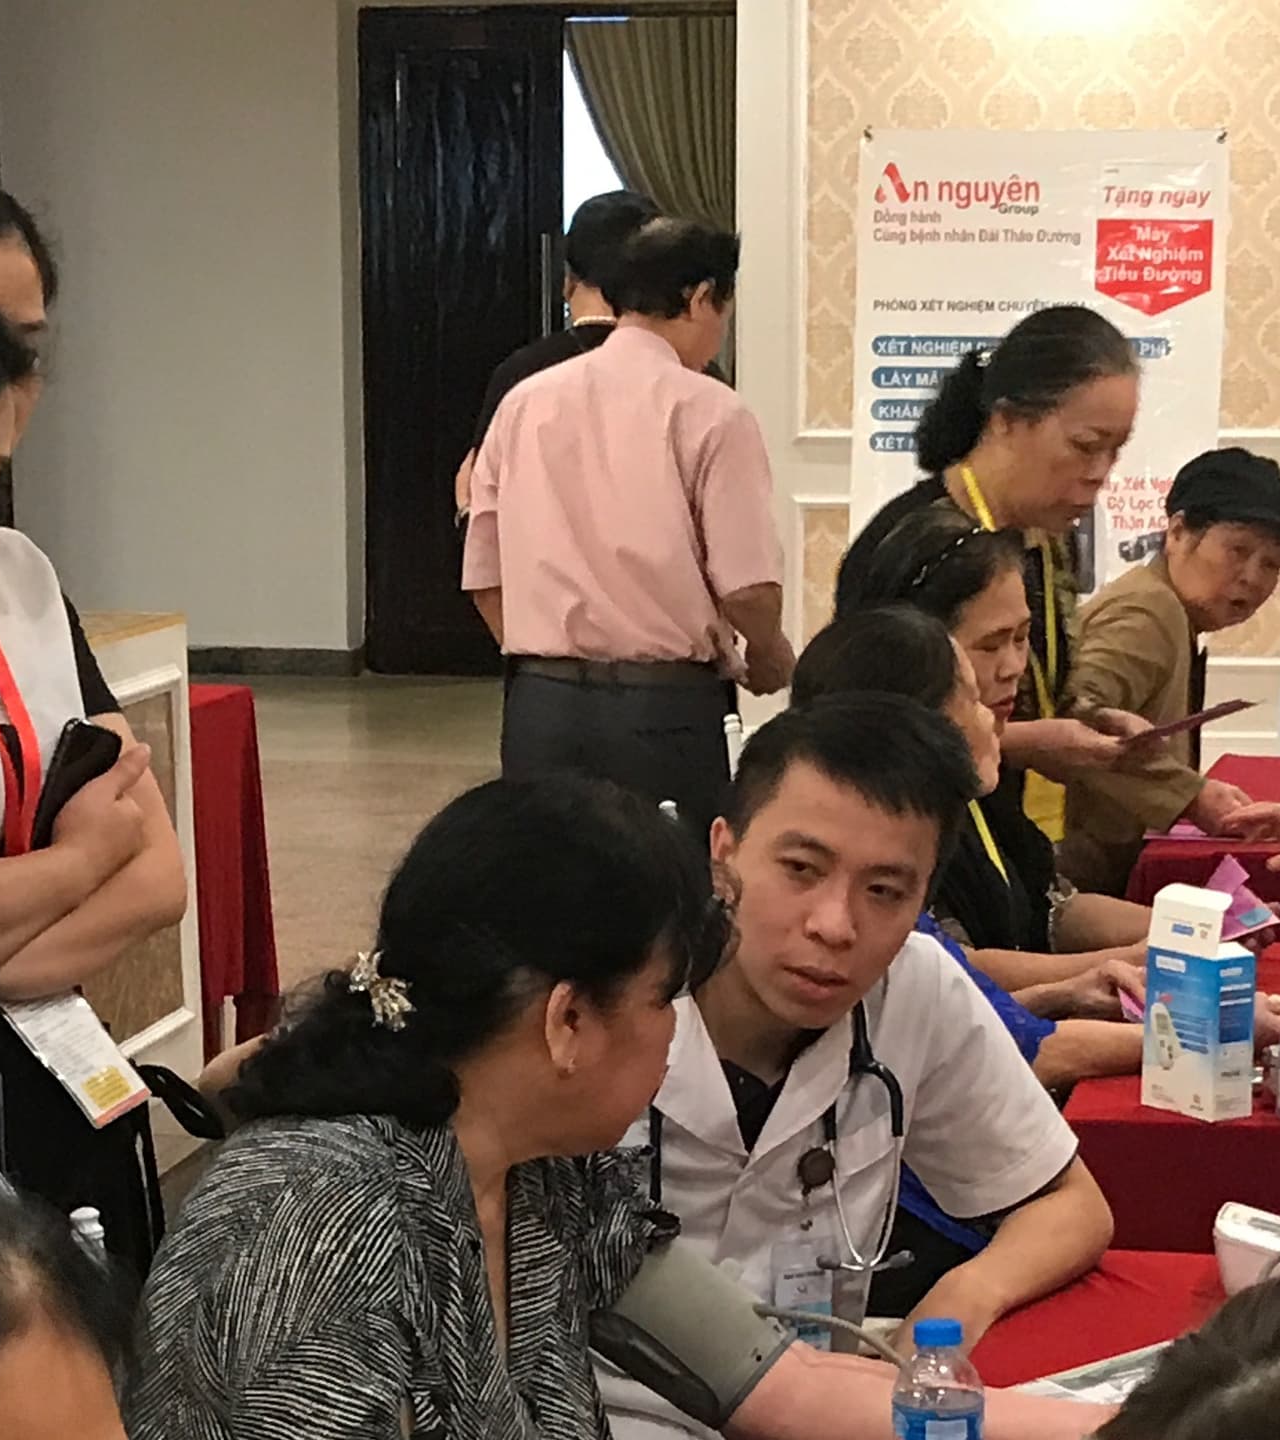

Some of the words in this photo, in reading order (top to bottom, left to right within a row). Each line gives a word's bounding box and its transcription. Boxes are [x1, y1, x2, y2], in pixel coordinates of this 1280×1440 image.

[938, 174, 1040, 209] nguyên
[1104, 186, 1153, 208] Tặng
[1159, 188, 1211, 208] ngay
[998, 203, 1040, 216] Group
[1143, 266, 1203, 285] Đường
[873, 298, 917, 312] PHÒNG
[947, 299, 995, 313] NGHIỆM
